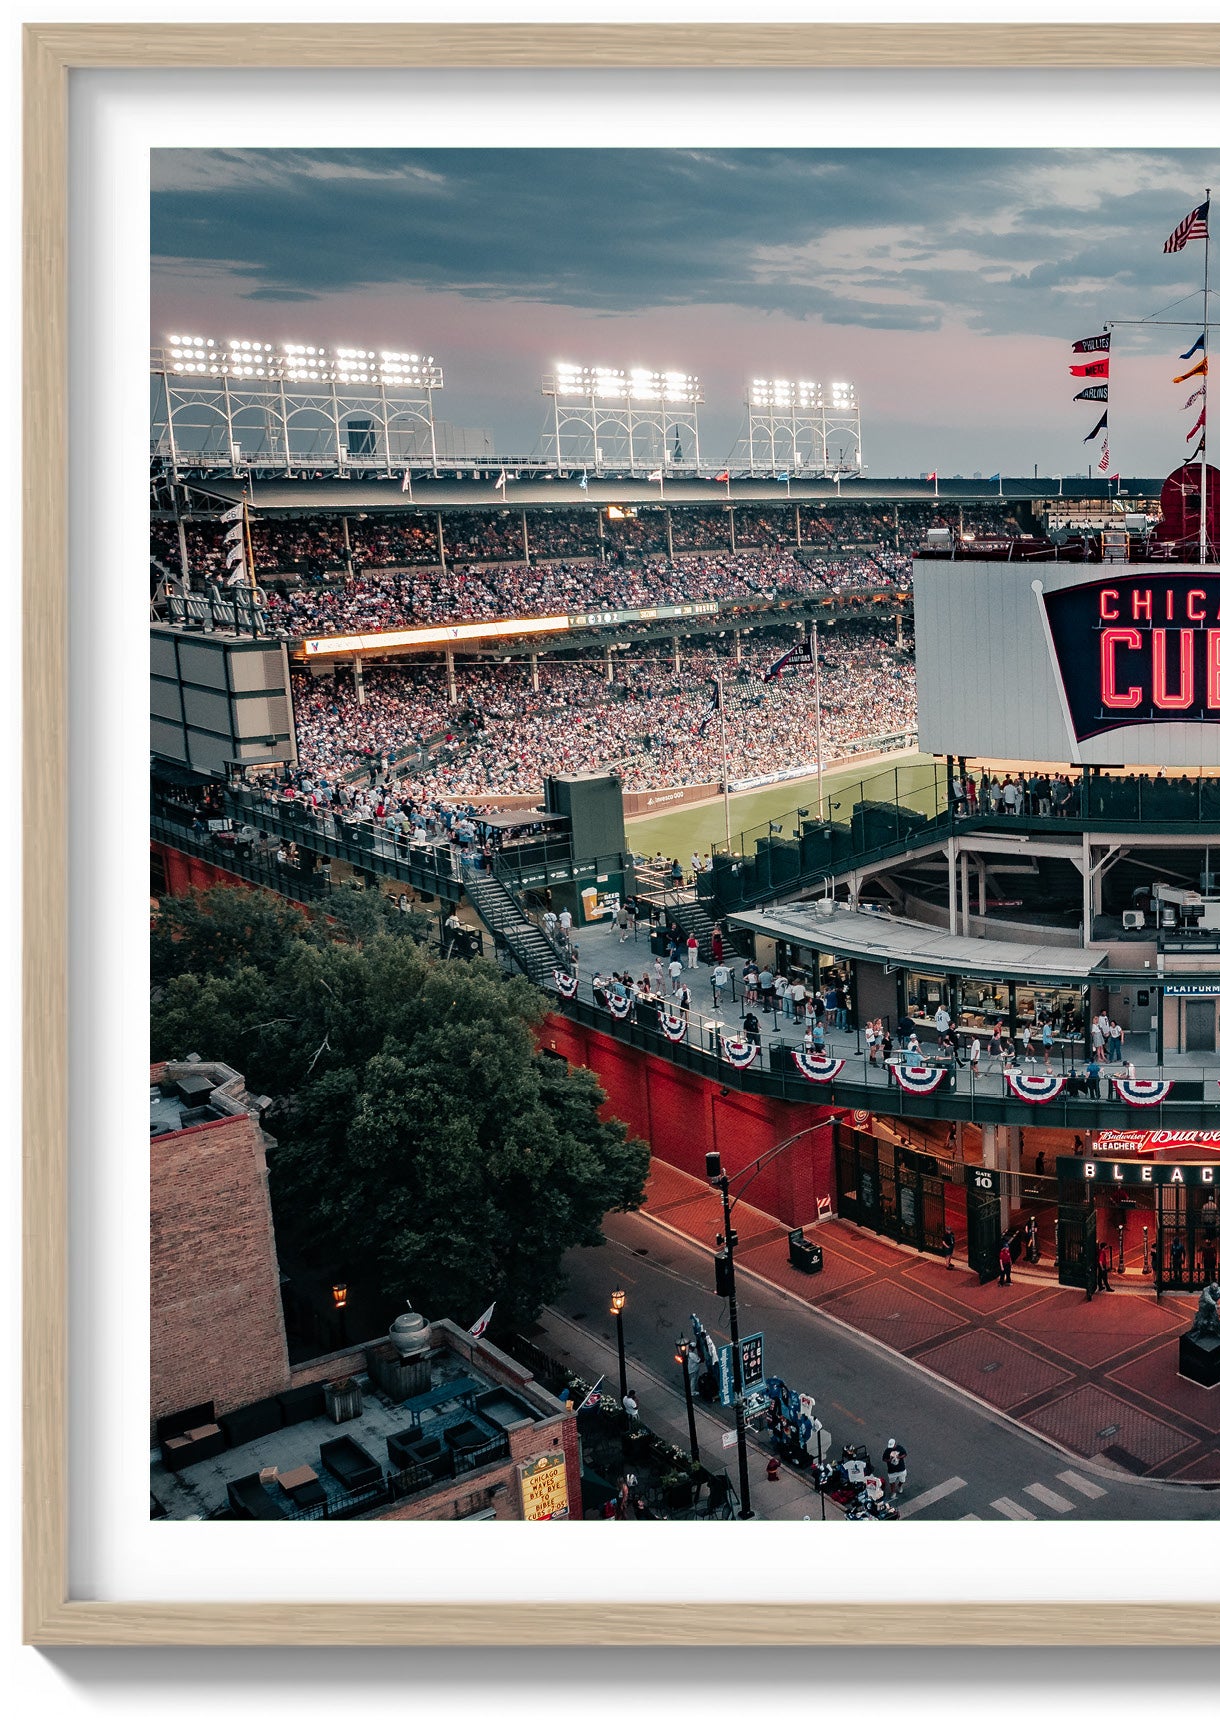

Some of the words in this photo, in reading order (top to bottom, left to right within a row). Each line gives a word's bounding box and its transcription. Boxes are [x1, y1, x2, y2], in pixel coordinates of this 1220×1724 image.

[1082, 337, 1109, 352] PHILLIES
[1085, 363, 1105, 377] METS
[226, 510, 237, 519] 26
[1166, 985, 1220, 993] PLATFORM
[1102, 1131, 1146, 1140] Budweiser
[1093, 1142, 1136, 1151] BLEACHER
[975, 1170, 992, 1178] GATE
[974, 1176, 993, 1189] 10
[529, 1469, 559, 1485] CHICAGO
[532, 1478, 555, 1491] WAVES
[530, 1490, 543, 1500] BYE
[547, 1482, 560, 1492] BYE
[541, 1494, 550, 1503] TO
[528, 1510, 546, 1521] CUBS
